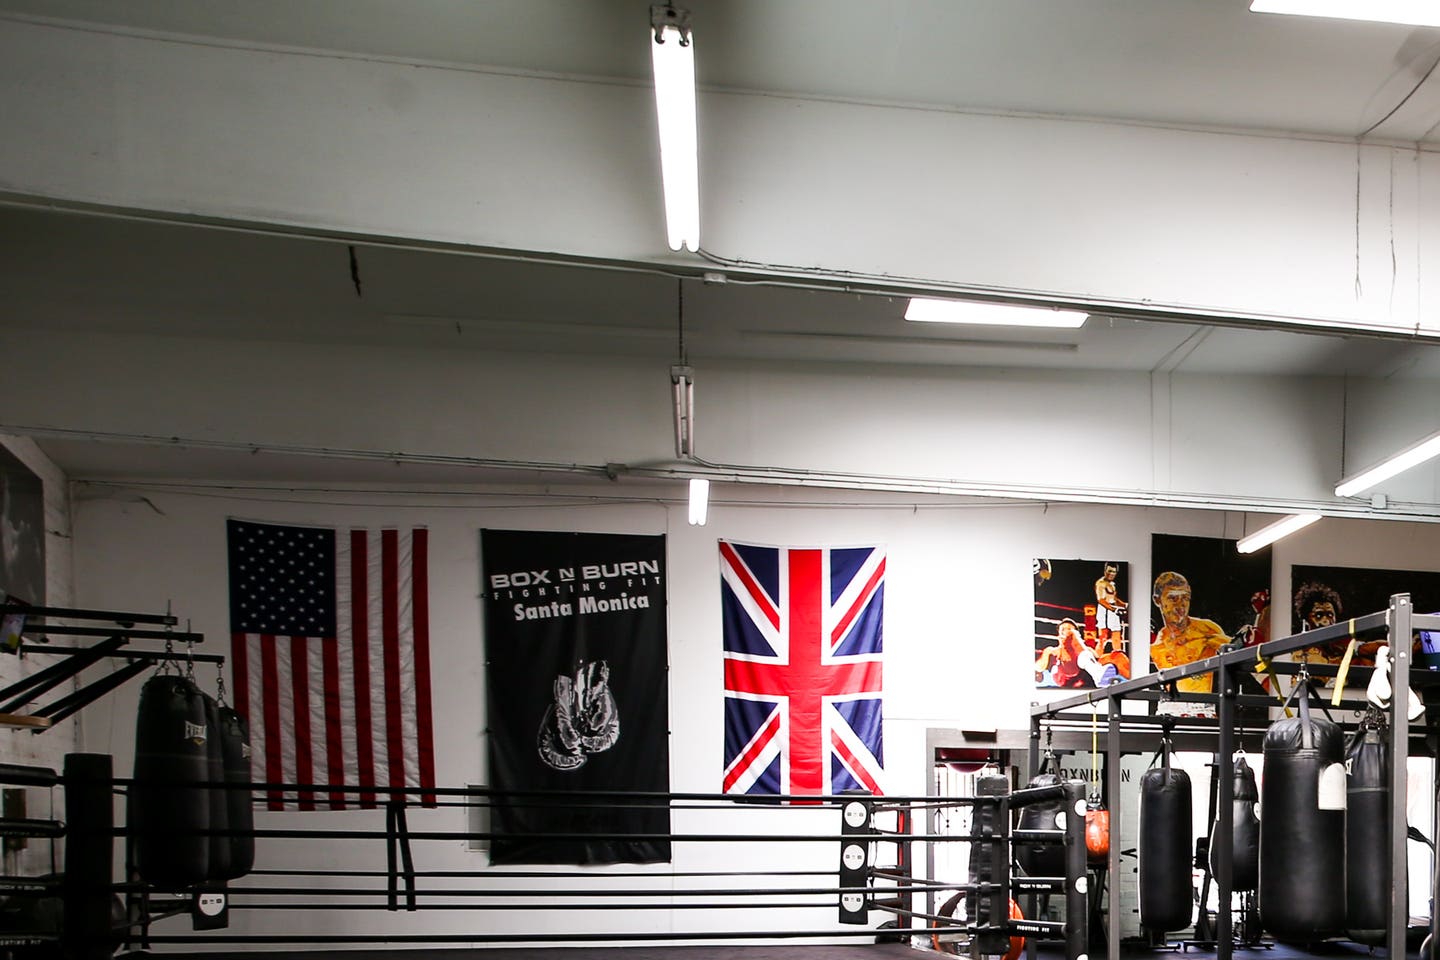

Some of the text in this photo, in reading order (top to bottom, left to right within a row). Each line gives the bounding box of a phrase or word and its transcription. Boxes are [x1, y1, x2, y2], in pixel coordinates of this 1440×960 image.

[490, 560, 660, 589] BOX N BURN
[494, 576, 661, 601] FIGHTING FIT
[514, 592, 650, 621] Santa Monica
